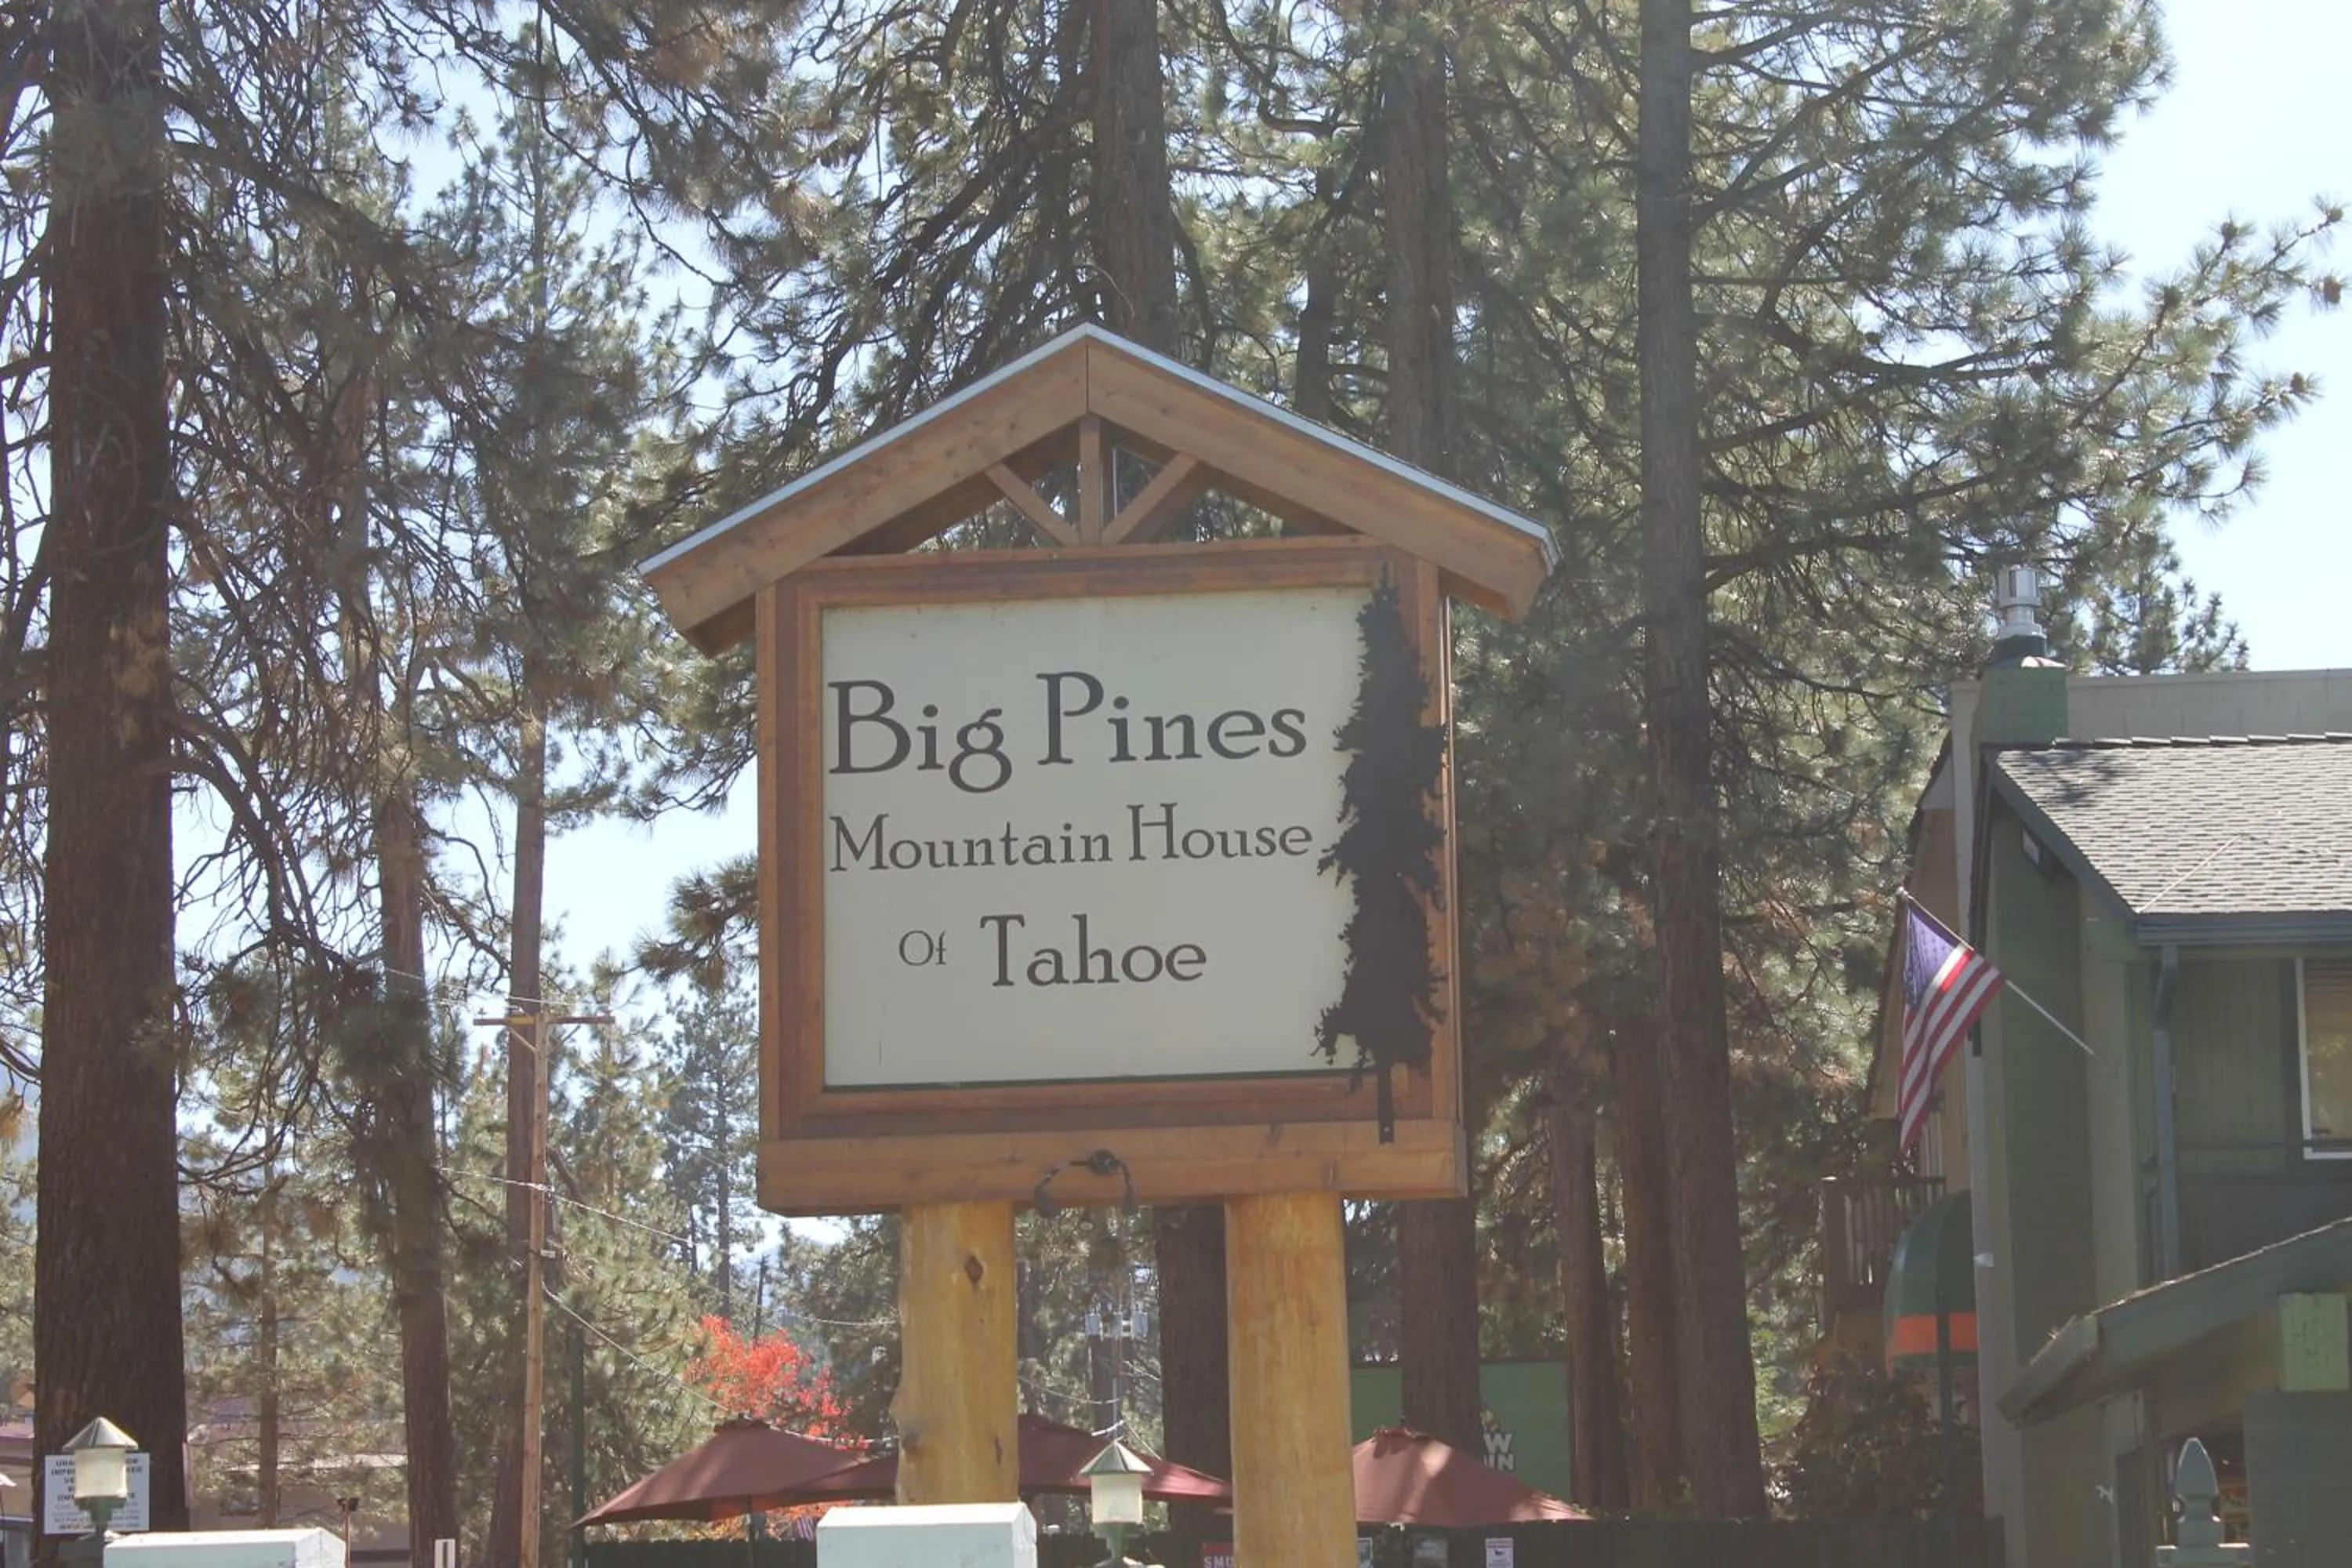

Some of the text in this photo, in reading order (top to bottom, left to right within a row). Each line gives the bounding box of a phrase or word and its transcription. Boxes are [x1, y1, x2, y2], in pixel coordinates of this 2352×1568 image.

[828, 671, 1307, 793] Big Pines
[829, 803, 1313, 872] Mountain House
[898, 913, 1207, 986] Of Tahoe
